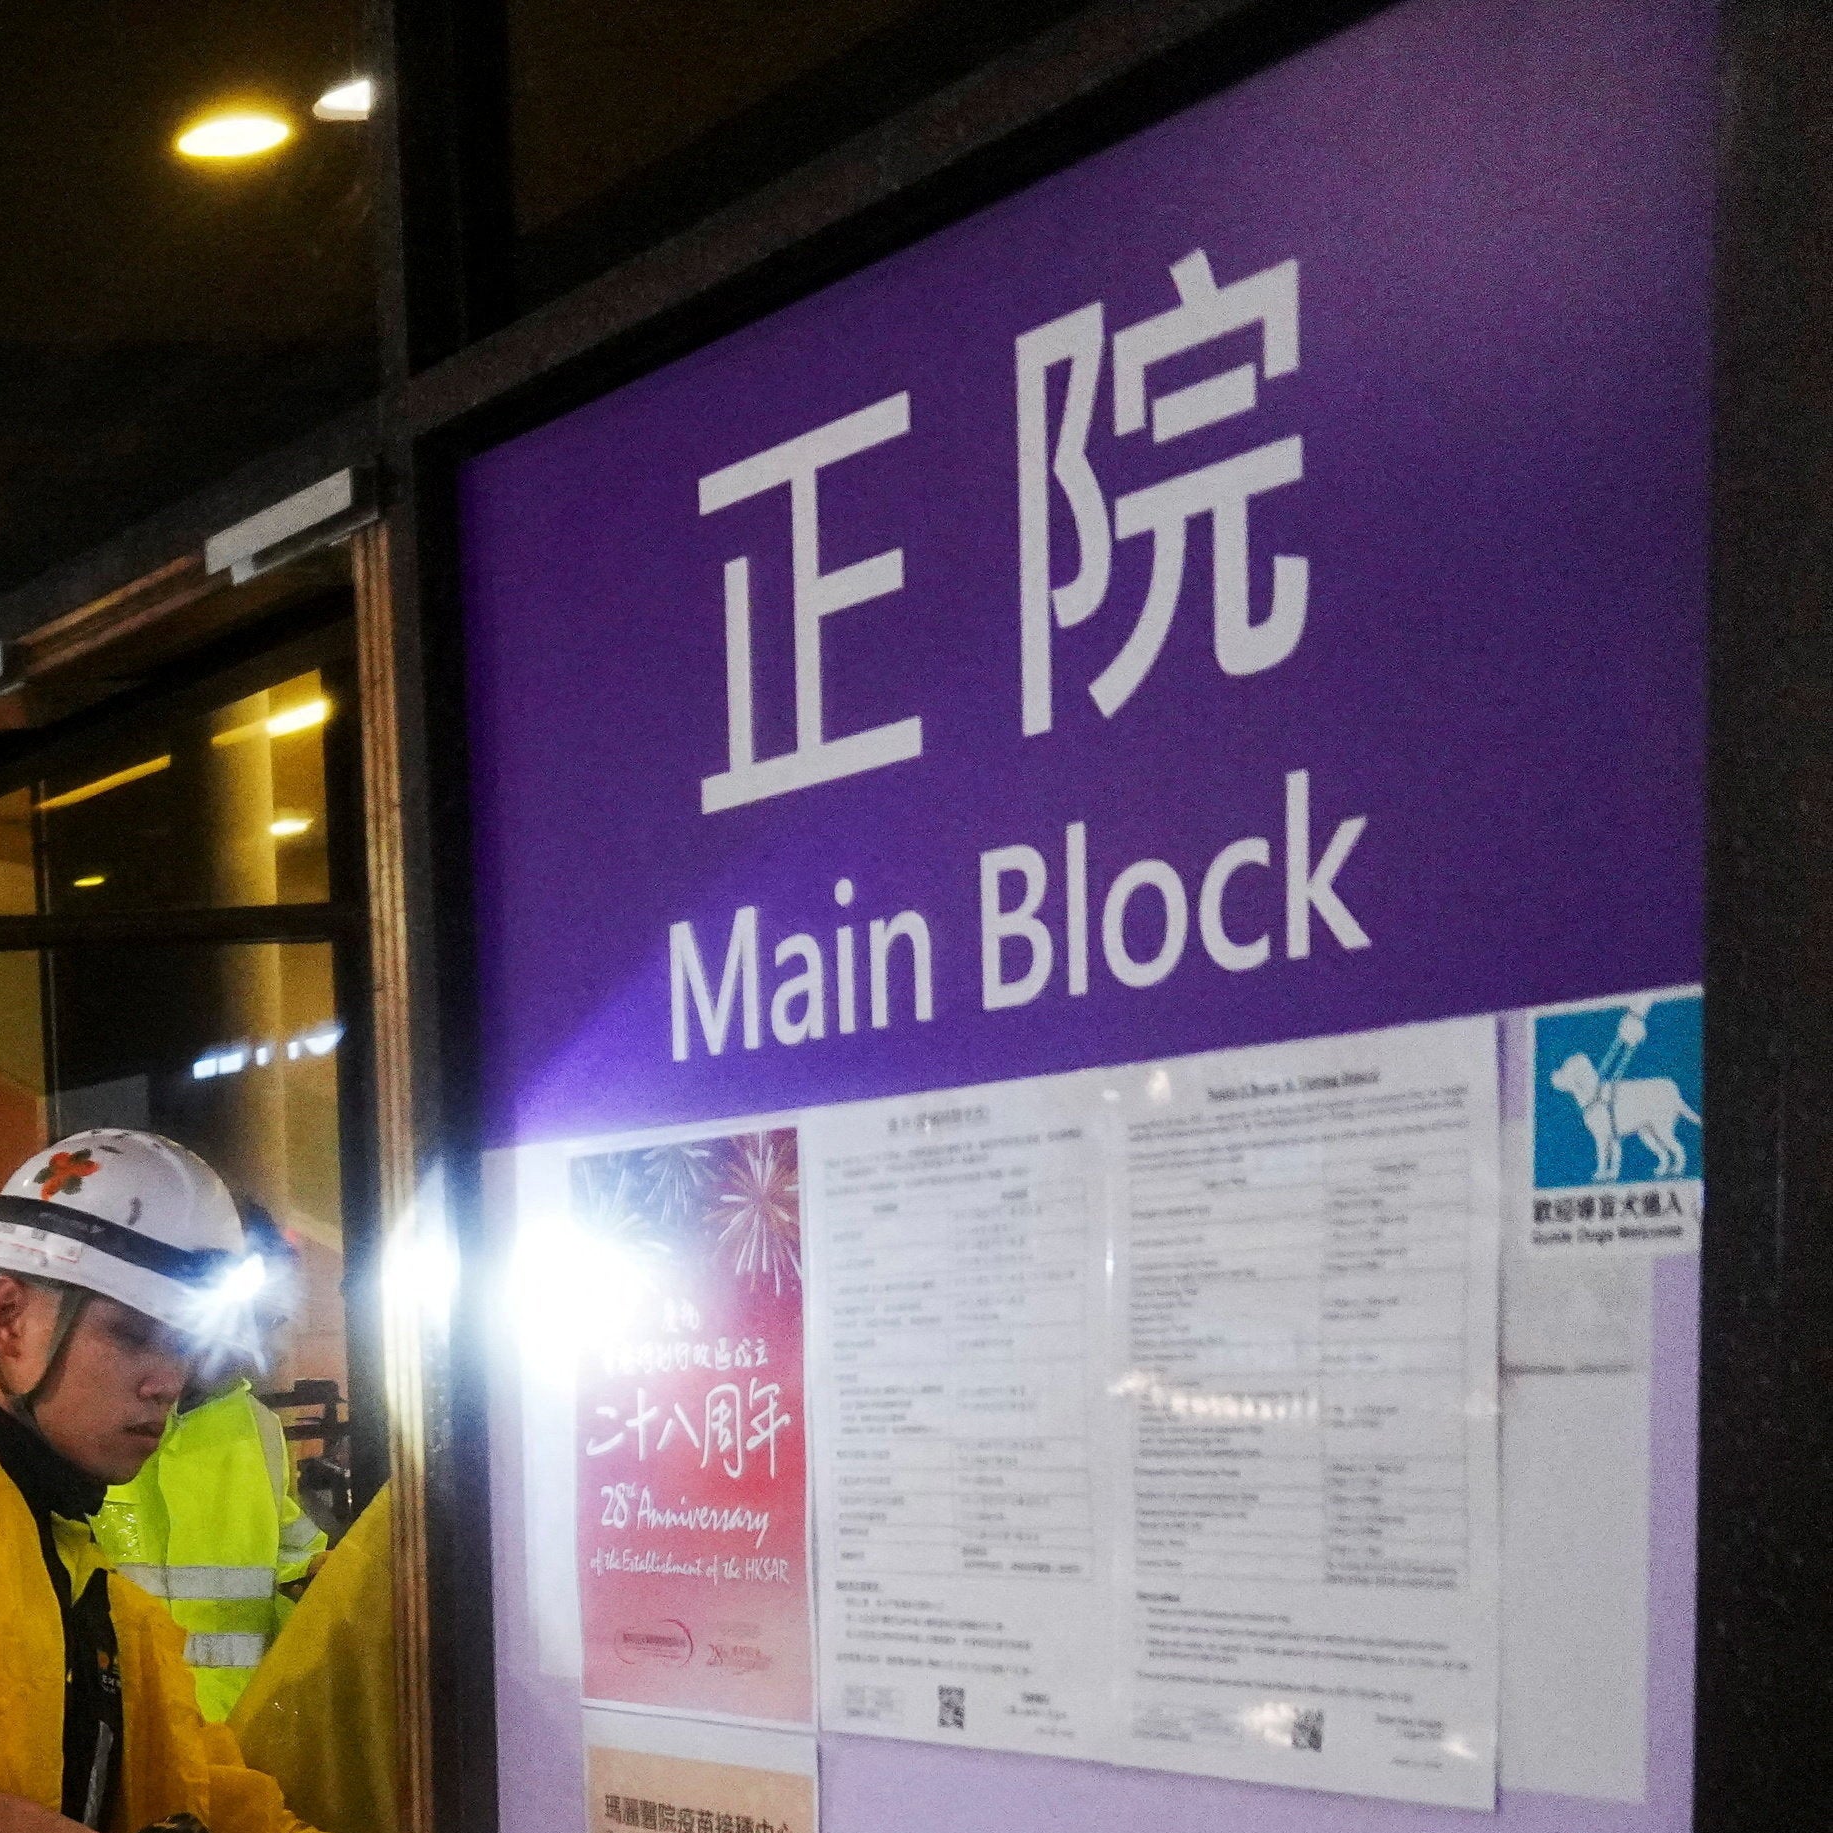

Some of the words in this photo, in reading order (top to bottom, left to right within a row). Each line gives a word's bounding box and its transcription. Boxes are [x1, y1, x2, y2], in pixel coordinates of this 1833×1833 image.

[699, 249, 1309, 815] 正院
[669, 878, 933, 1063] Main
[979, 769, 1371, 1013] Block
[622, 1550, 702, 1577] Establishment
[745, 1557, 790, 1585] HKSAR
[637, 1487, 771, 1549] Anniversary
